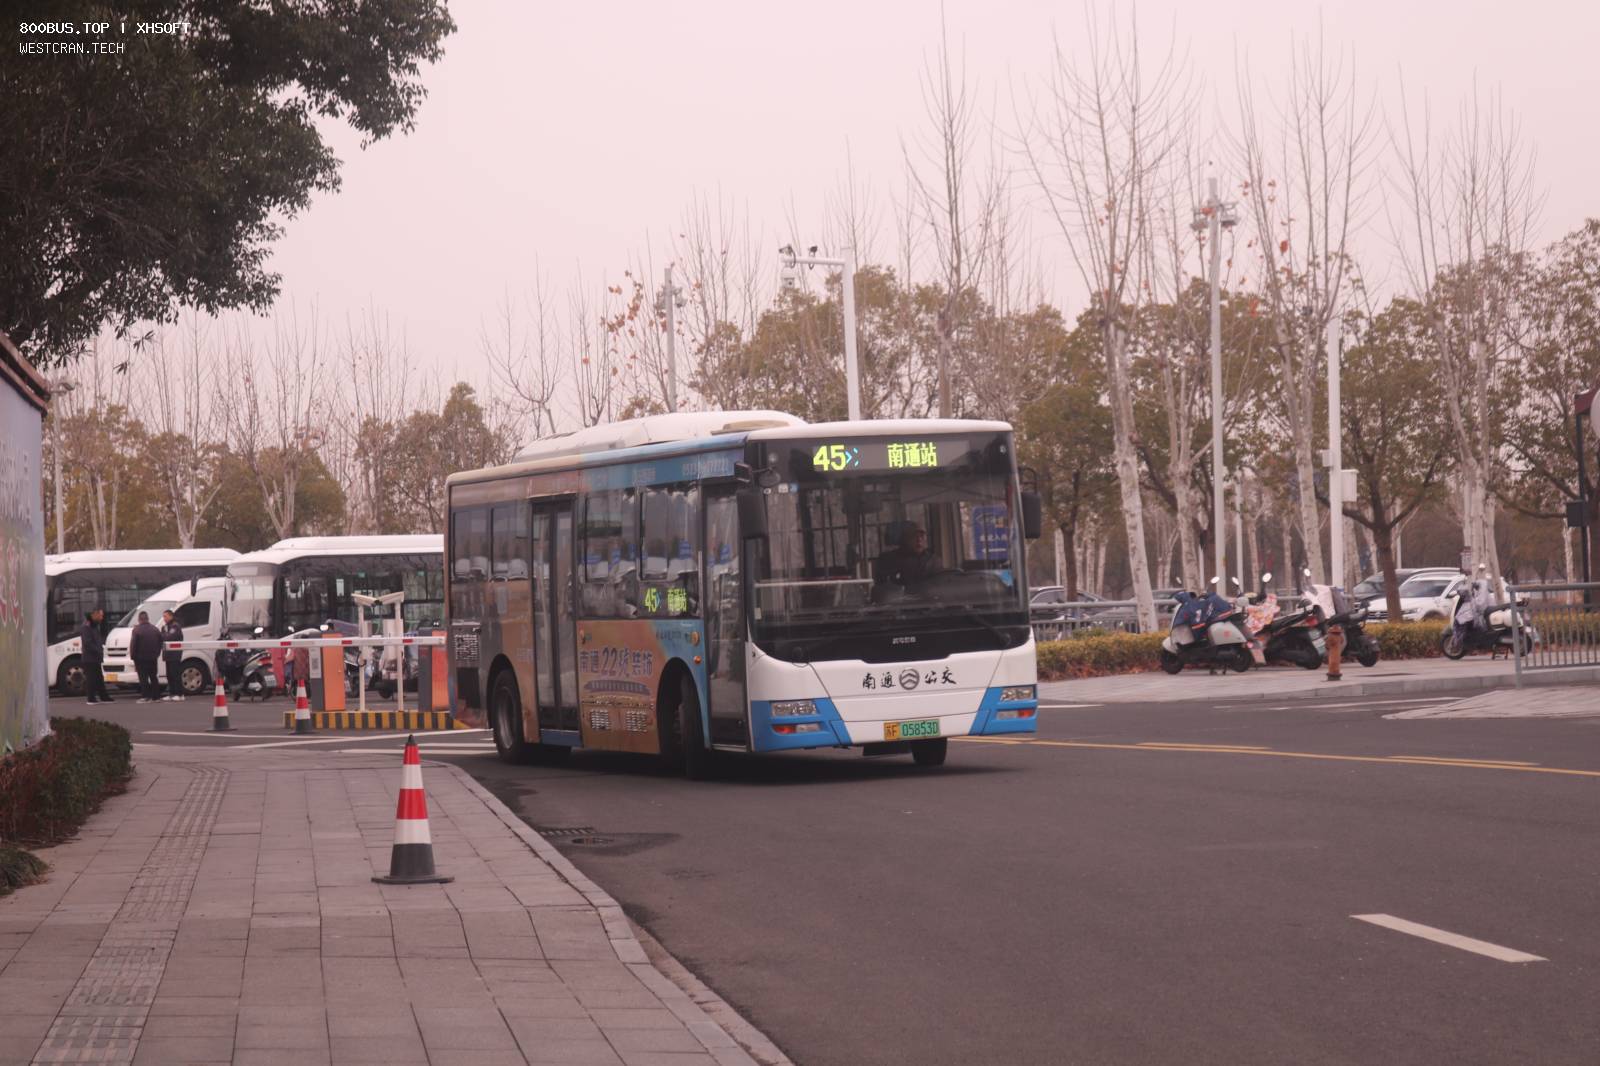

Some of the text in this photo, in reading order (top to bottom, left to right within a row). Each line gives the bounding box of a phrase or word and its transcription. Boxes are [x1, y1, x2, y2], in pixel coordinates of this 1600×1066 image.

[812, 442, 938, 471] 45 南通站
[645, 587, 657, 613] 45
[862, 666, 957, 690] 南通 公交
